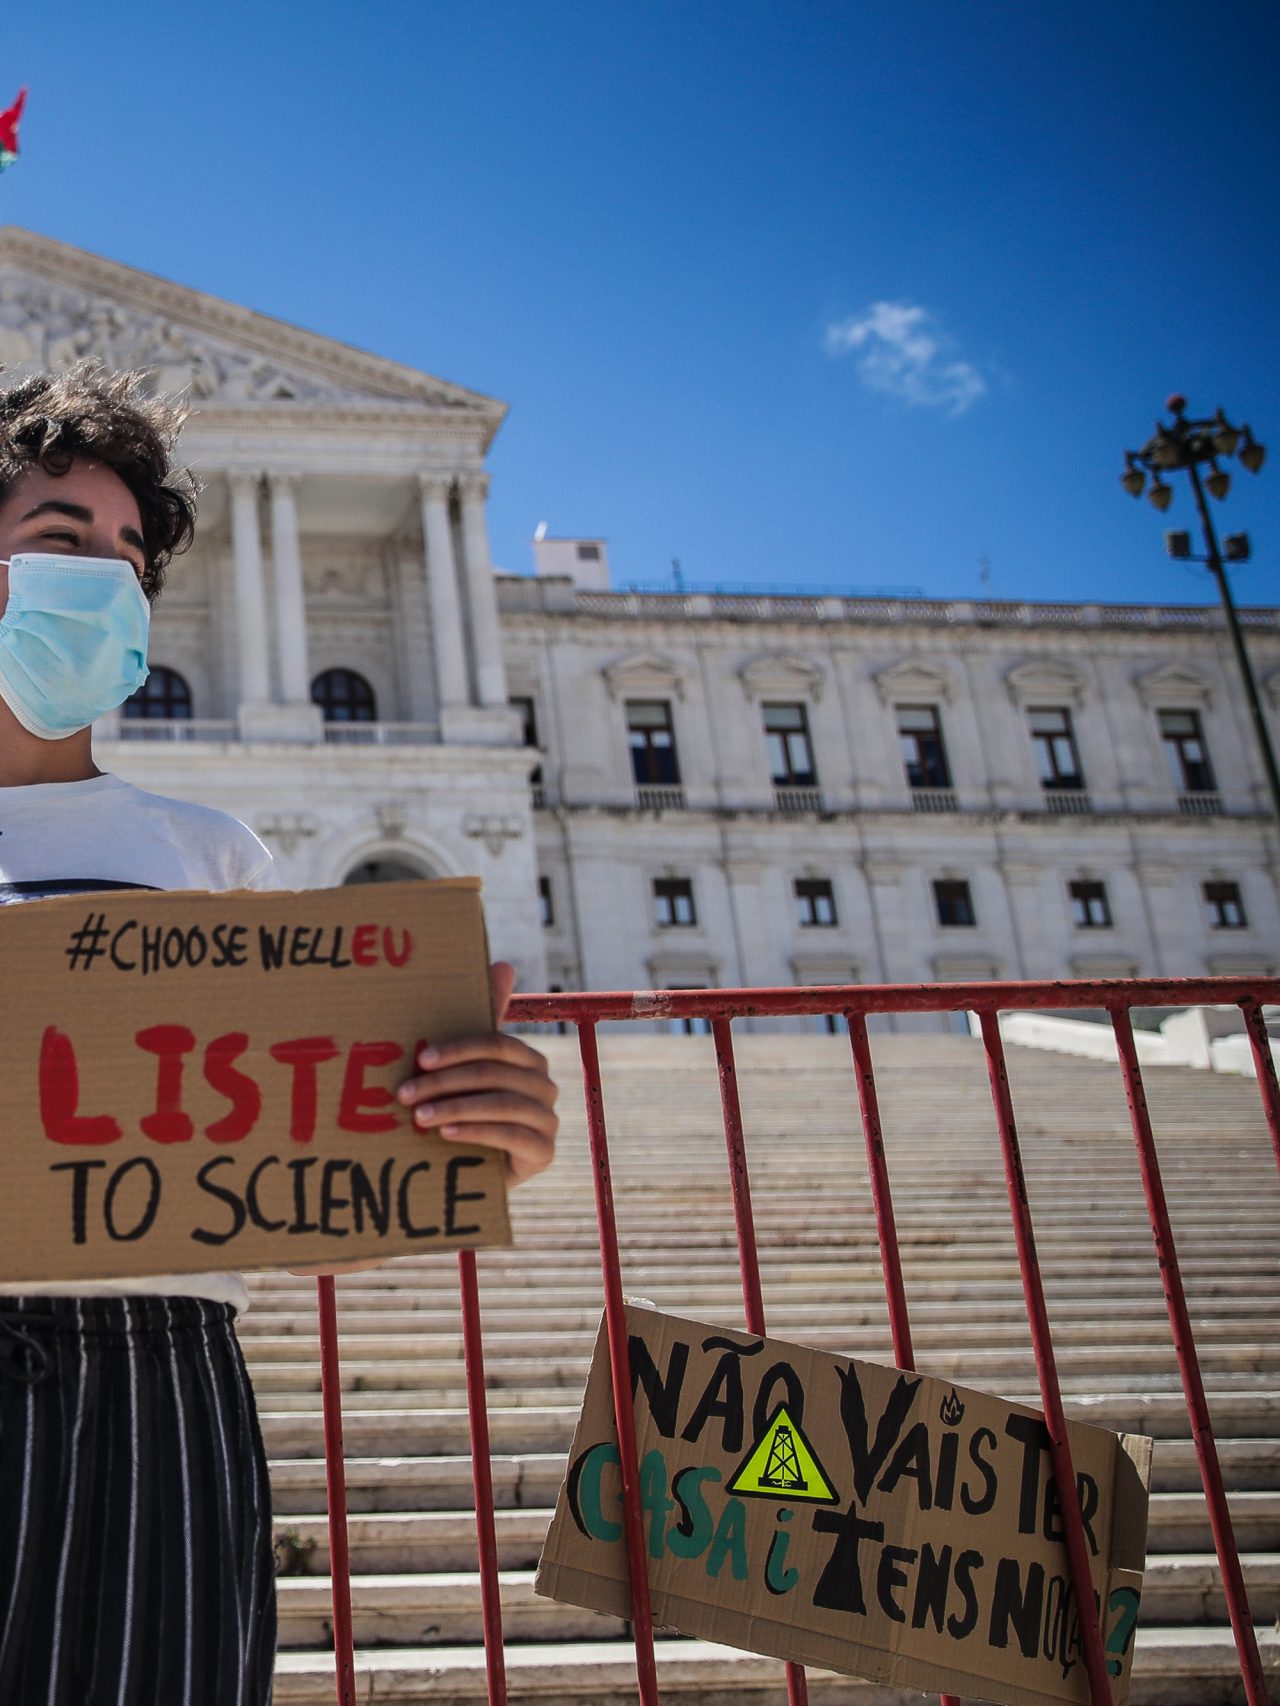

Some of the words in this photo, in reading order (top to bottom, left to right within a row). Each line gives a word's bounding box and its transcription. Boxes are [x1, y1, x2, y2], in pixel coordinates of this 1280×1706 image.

[37, 1023, 430, 1146] LISTE
[48, 1156, 163, 1245] TO
[190, 1154, 488, 1246] SCIENCE
[612, 1335, 805, 1454] NÃO
[566, 1442, 749, 1582] CASA
